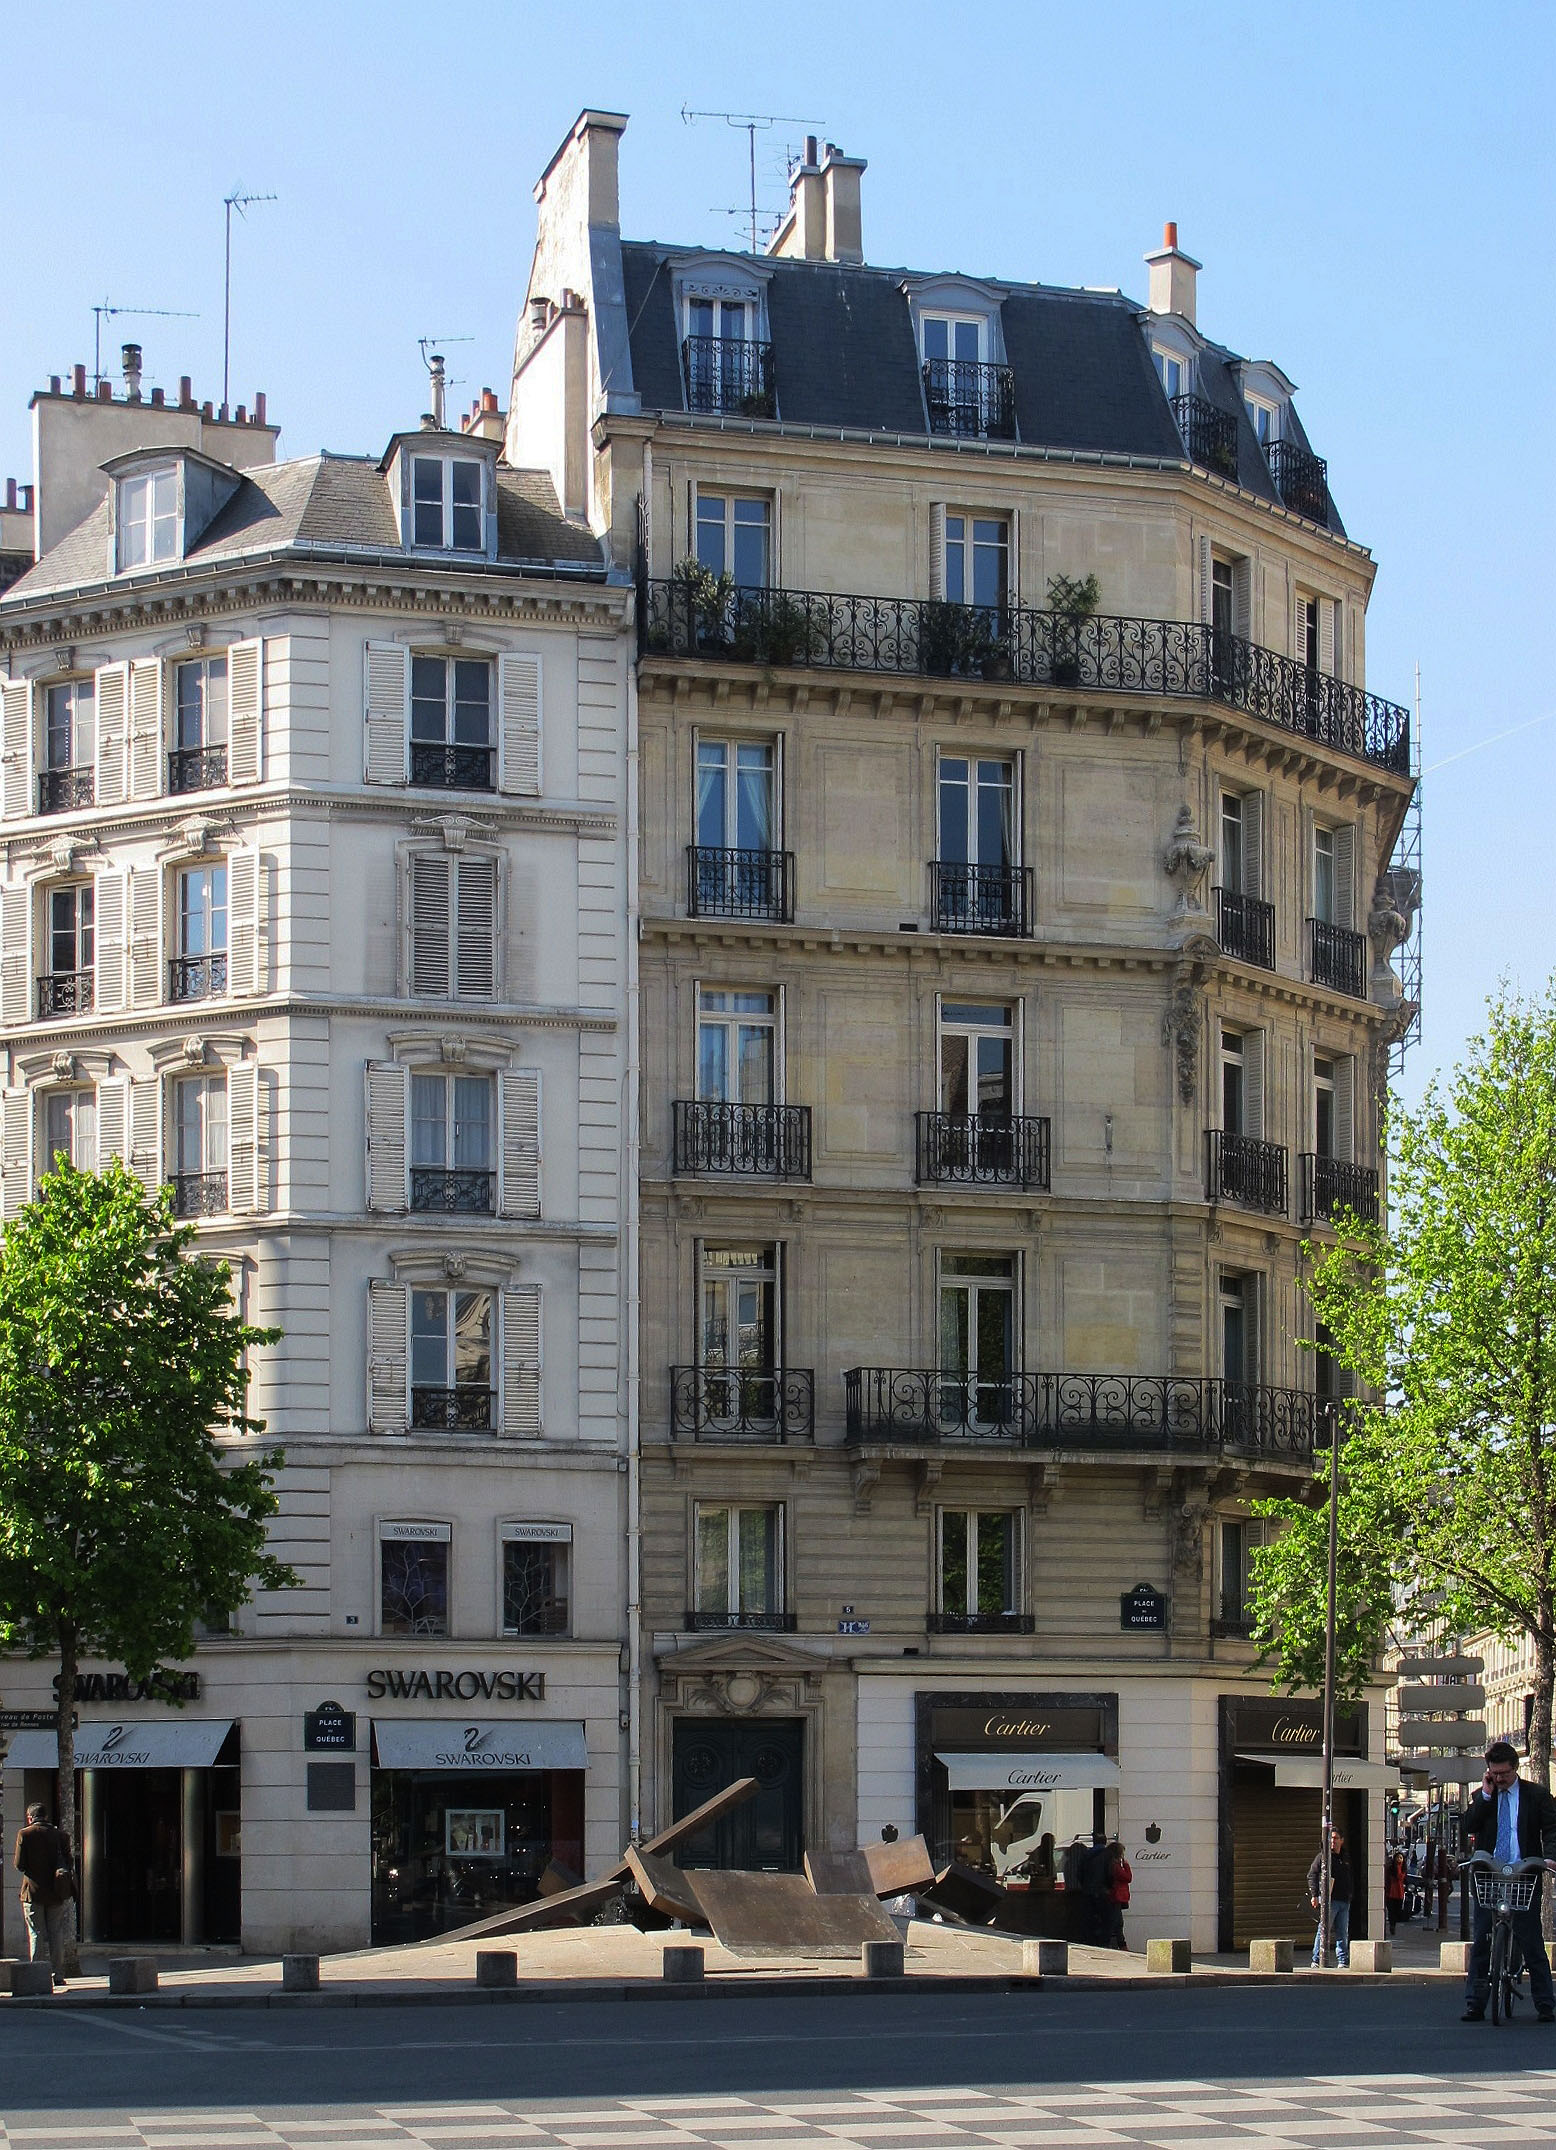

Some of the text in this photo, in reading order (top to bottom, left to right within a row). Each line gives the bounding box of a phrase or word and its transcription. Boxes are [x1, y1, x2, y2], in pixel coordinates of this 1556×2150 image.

[393, 1527, 438, 1537] SWAROVSKI
[514, 1528, 560, 1537] SWAROVSKI
[1130, 1615, 1158, 1623] QUÉBEC
[366, 1669, 547, 1701] SWAROVSKI
[984, 1715, 1051, 1736] Cartier
[1271, 1716, 1320, 1743] Cartier
[316, 1734, 345, 1743] QUÉBEC
[73, 1752, 150, 1764] SWAROVSKI
[435, 1753, 531, 1765] SWAROVSKI
[1008, 1769, 1062, 1784] Cartier
[1135, 1849, 1171, 1861] Cartier
